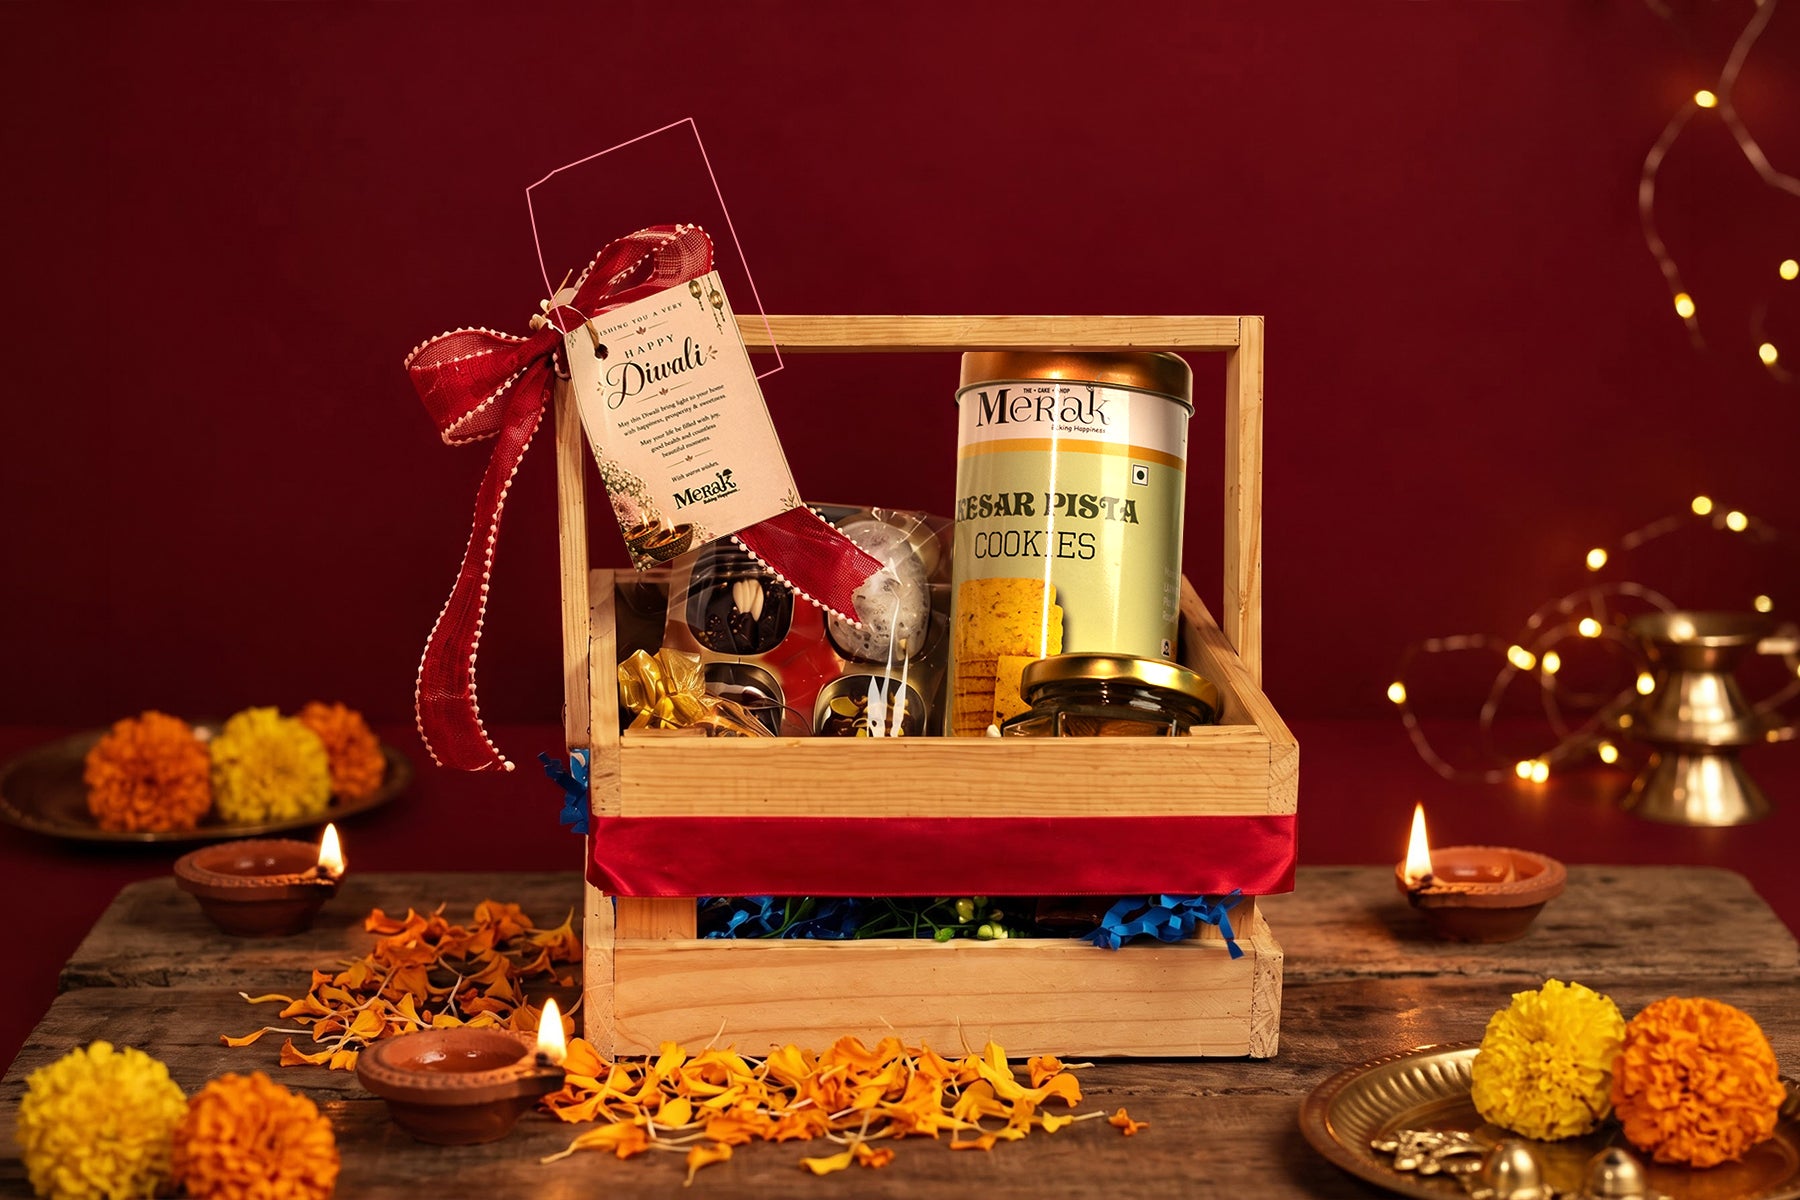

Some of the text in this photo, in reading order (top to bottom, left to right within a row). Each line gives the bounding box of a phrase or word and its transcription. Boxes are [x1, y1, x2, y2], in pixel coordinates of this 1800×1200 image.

[599, 321, 629, 337] ISHING
[631, 314, 649, 324] YOU
[661, 302, 683, 313] VERY
[624, 334, 674, 359] HAPPY
[606, 336, 707, 410] Diwali
[617, 420, 630, 429] May
[630, 415, 641, 423] this
[641, 408, 660, 419] Diwali
[660, 403, 676, 412] bring
[675, 397, 689, 406] light
[696, 390, 709, 399] your
[708, 384, 724, 394] home
[623, 428, 637, 436] with
[636, 418, 665, 432] happiness,
[664, 406, 692, 421] prosperity
[699, 394, 726, 407] sweetness
[976, 385, 1111, 427] Merak
[639, 438, 652, 446] May
[652, 433, 665, 442] your
[664, 428, 675, 437] life
[674, 425, 682, 433] be
[682, 419, 697, 430] filled
[696, 415, 710, 424] with
[650, 423, 717, 453] good health and countless
[1051, 424, 1106, 434] Bking Happiness
[661, 444, 685, 458] beautiful
[671, 473, 685, 482] With
[685, 468, 701, 478] warm
[672, 468, 737, 510] Merak
[957, 491, 1139, 525] KESAR PISTA
